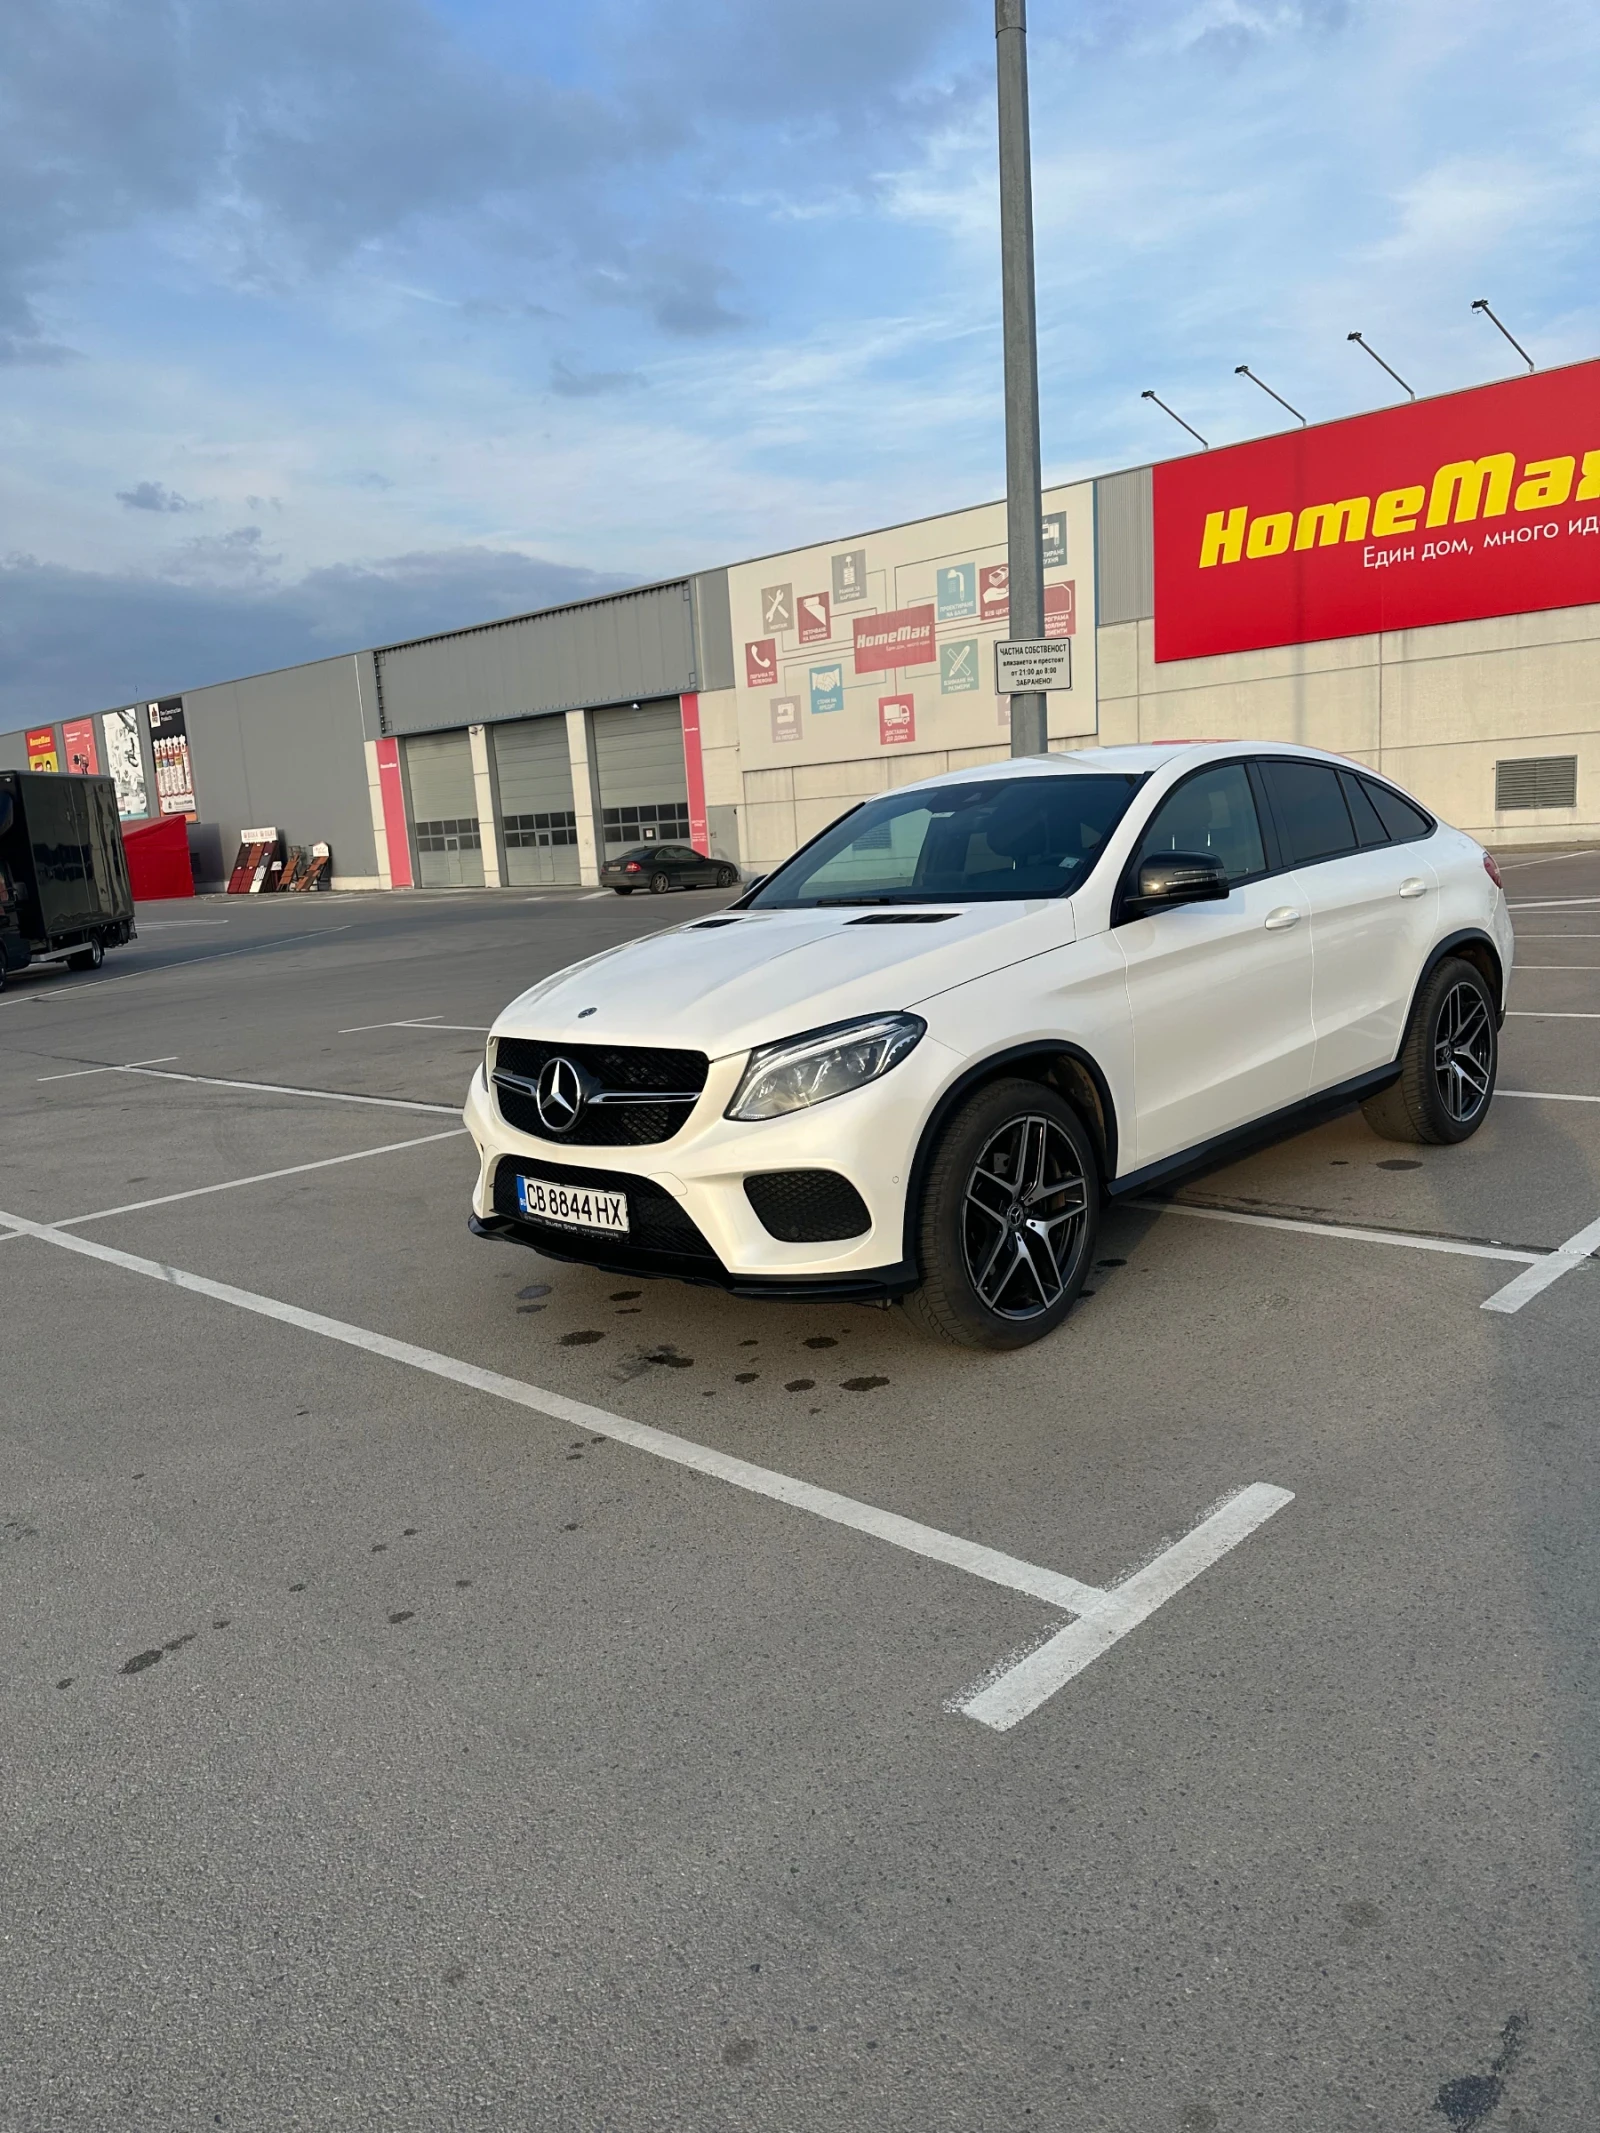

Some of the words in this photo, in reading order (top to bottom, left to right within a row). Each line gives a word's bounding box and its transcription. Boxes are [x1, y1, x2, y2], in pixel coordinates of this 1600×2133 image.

[1364, 545, 1415, 569] Един
[1421, 538, 1474, 561] дом,
[1483, 522, 1559, 548] много
[1568, 515, 1600, 536] ид
[940, 601, 974, 612] ПРОЕКТИРАНЕ
[996, 606, 1009, 616] ЦЕНТ
[1044, 614, 1069, 623] РОГРАМА
[857, 625, 931, 649] HomeMax
[1000, 647, 1023, 655] ЧАСТНА
[1025, 644, 1066, 654] СОБСТВЕНОСТ
[1019, 668, 1034, 676] 21:00
[1016, 677, 1052, 686] ЗАБРАНЕНО!
[527, 1184, 546, 1212] CB
[549, 1189, 592, 1221] 8844
[595, 1196, 623, 1226] HX
